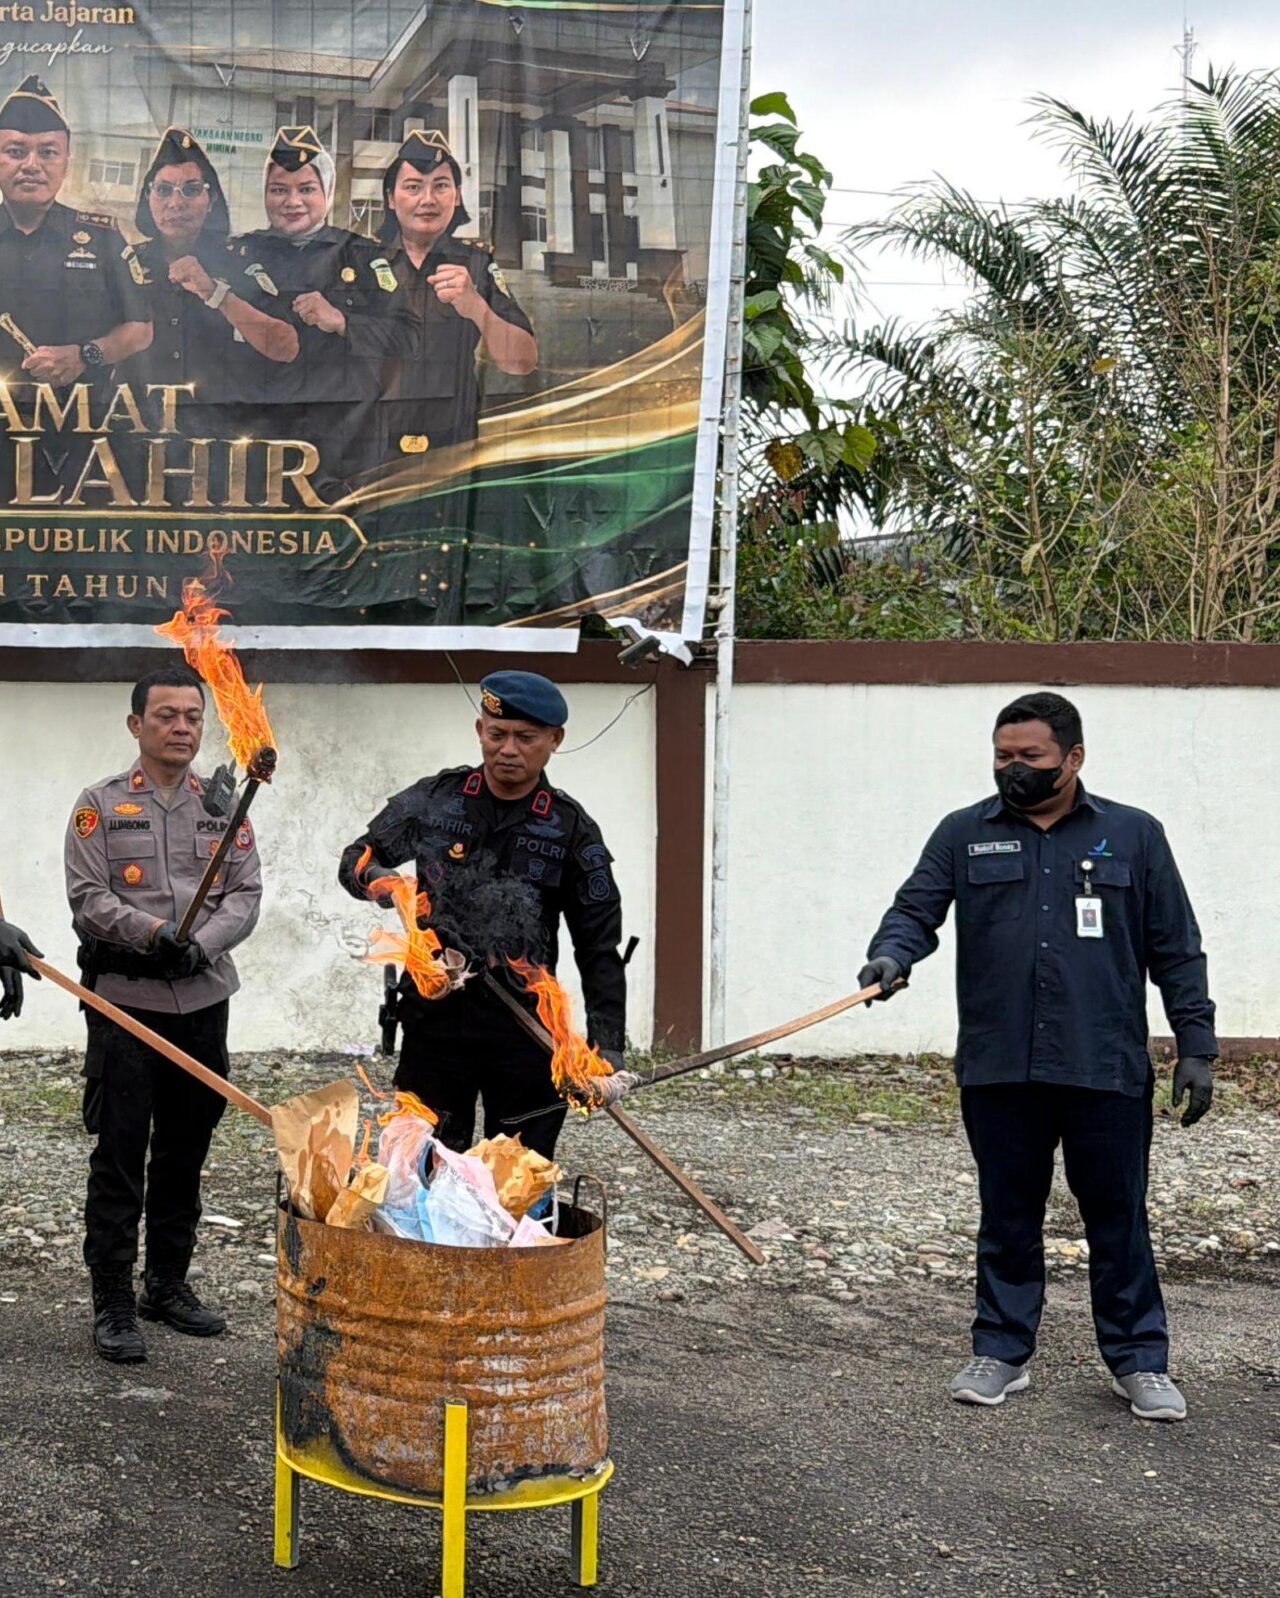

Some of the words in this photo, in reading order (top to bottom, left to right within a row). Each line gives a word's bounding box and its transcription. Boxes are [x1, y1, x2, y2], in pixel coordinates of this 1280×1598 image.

[39, 0, 136, 27] Jajaran
[8, 436, 331, 508] LAHIR
[145, 529, 339, 556] INDONESIA
[26, 573, 169, 599] TAHUN
[429, 816, 473, 835] TAHIR
[516, 836, 565, 860] POLRI
